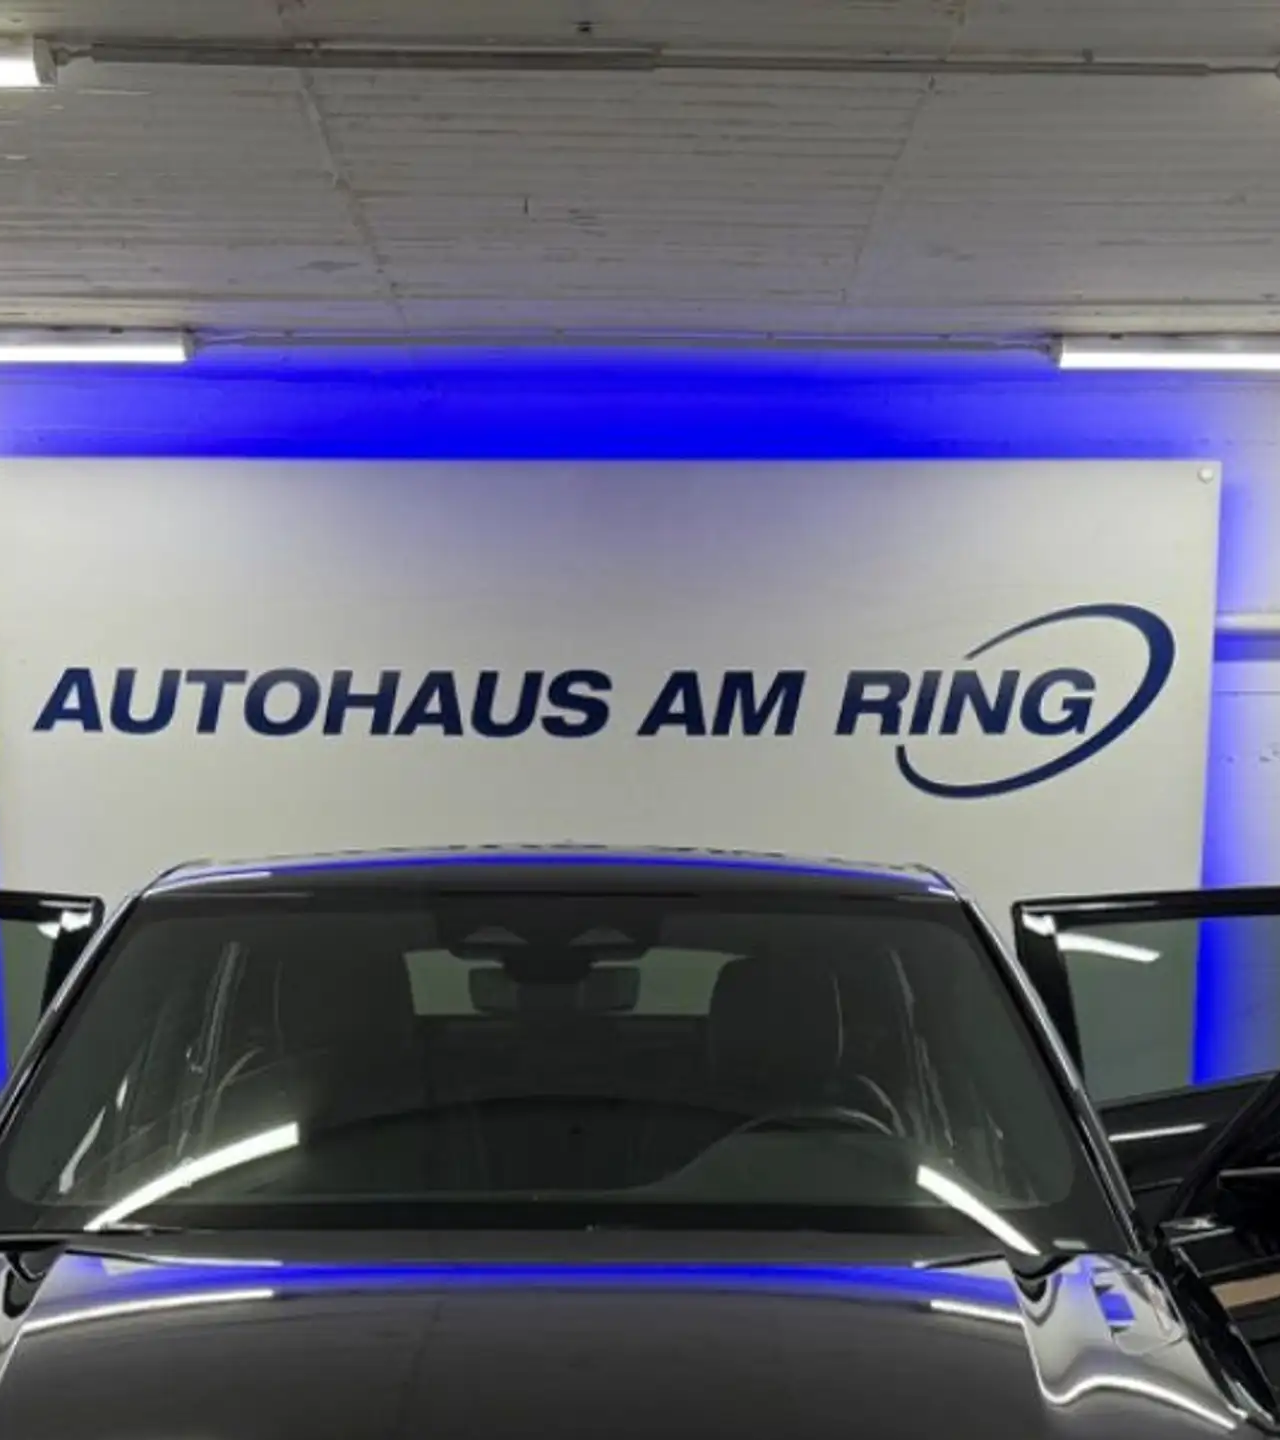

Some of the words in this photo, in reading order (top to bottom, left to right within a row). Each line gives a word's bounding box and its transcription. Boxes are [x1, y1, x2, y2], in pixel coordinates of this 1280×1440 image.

[33, 667, 612, 740] AUTOHAUS
[638, 668, 805, 738] AM
[835, 667, 1098, 738] RING
